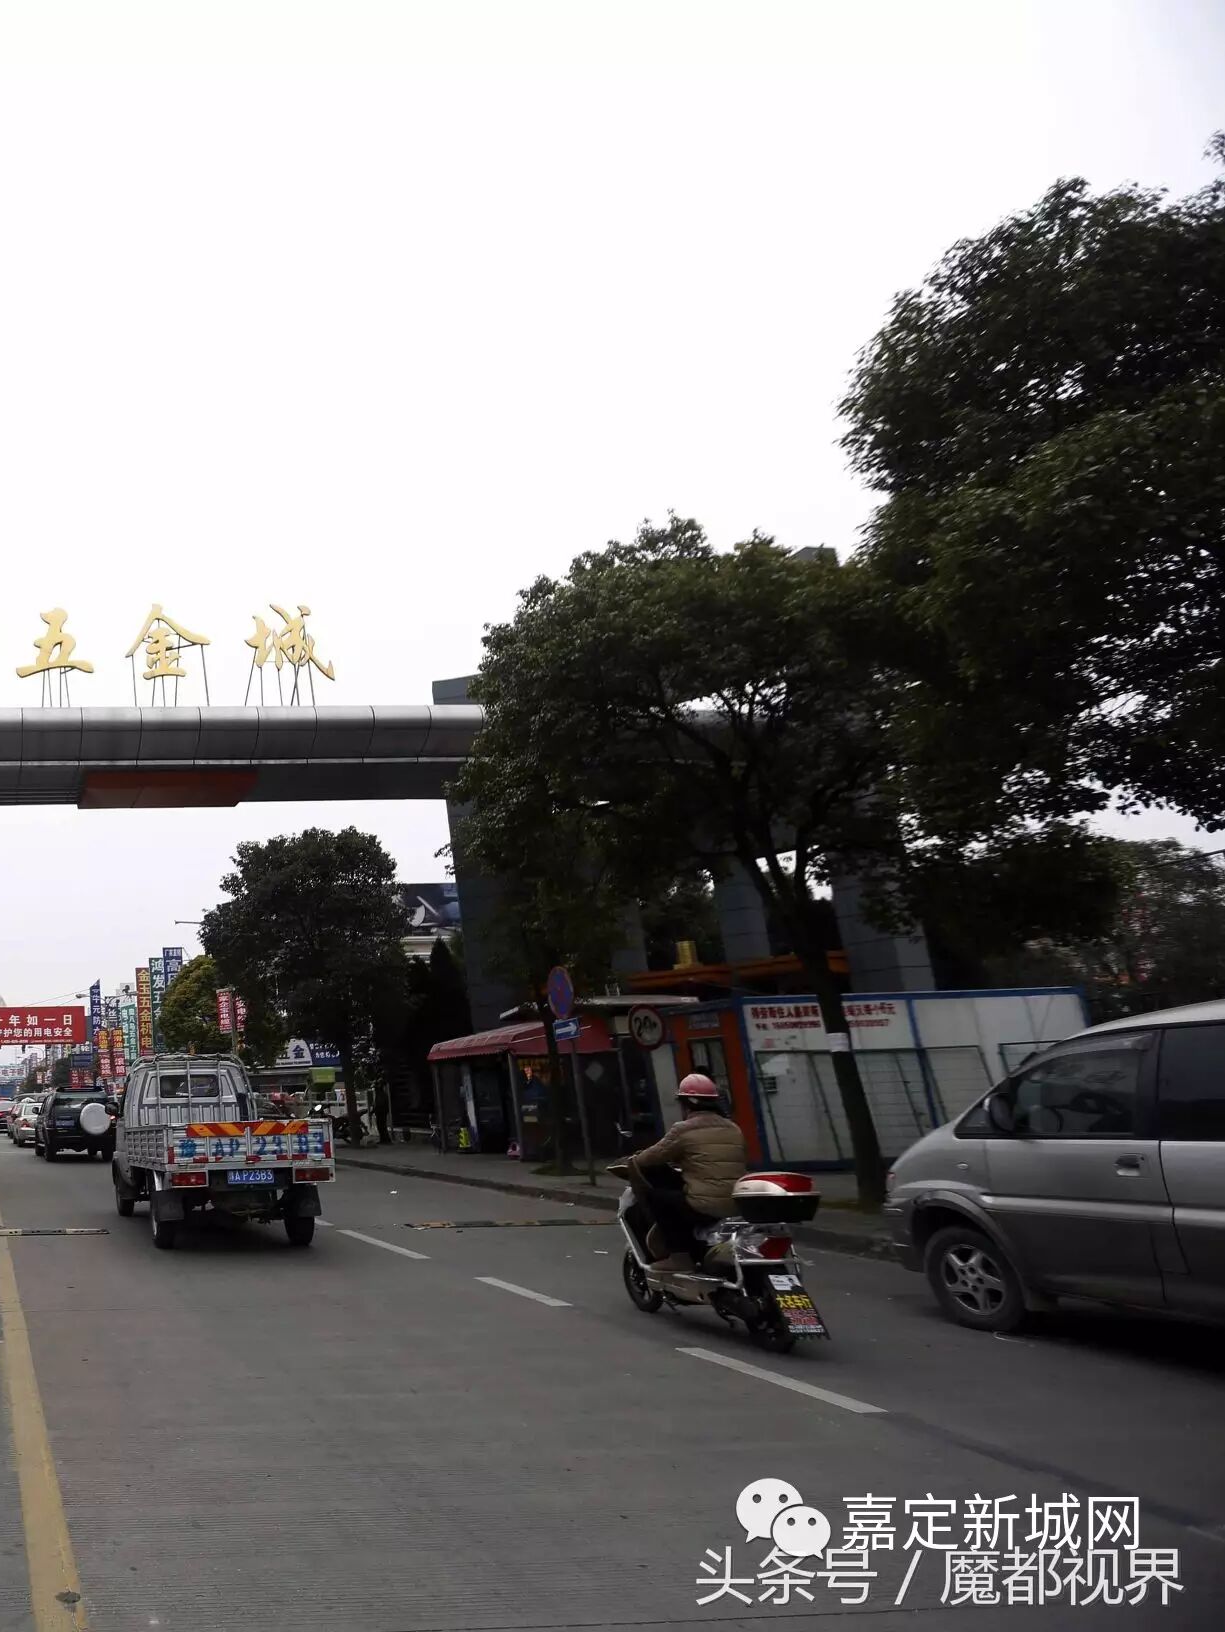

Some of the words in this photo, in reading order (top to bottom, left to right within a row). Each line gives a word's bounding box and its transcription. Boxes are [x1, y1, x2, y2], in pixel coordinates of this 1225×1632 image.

[138, 969, 152, 1048] 金玉五金机电
